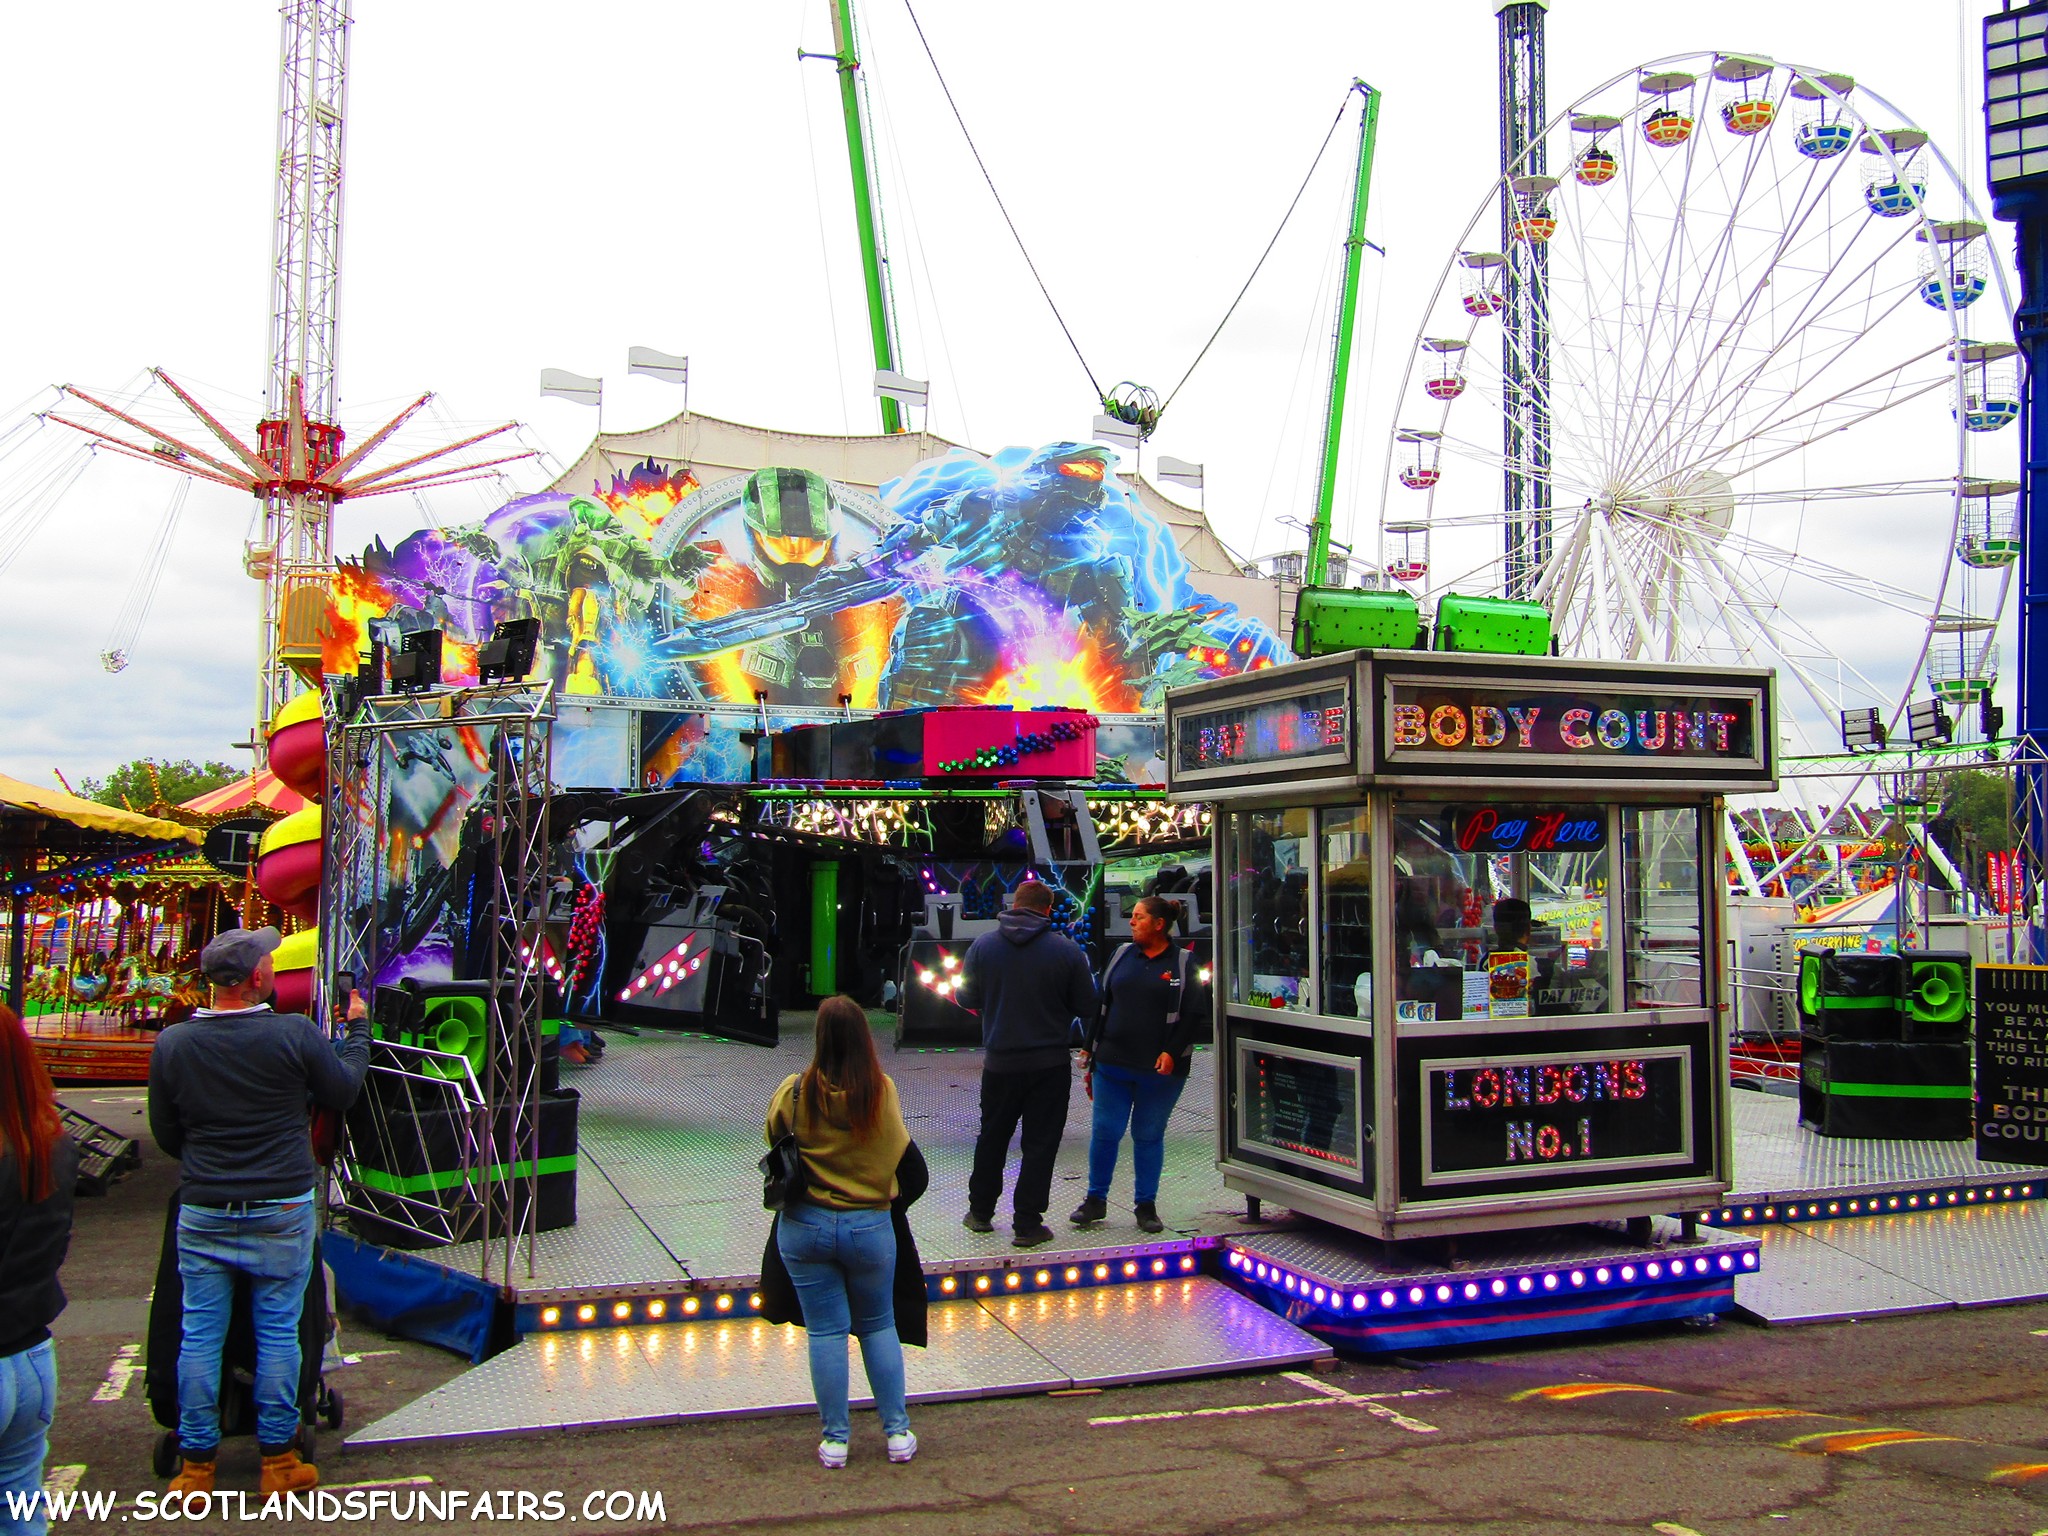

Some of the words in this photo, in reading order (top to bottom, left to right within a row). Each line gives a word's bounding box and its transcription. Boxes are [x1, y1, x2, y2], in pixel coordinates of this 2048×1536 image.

[1199, 722, 1247, 762] PAY
[1255, 704, 1345, 754] HERE
[1394, 704, 1540, 747] BODY
[1559, 708, 1737, 751] COUNT
[1461, 809, 1528, 850] Pay
[1531, 812, 1600, 850] Here
[1566, 917, 1589, 931] WIN
[1541, 990, 1565, 1003] PAY
[1570, 986, 1601, 1002] HERE
[1984, 1002, 2020, 1013] YOU
[2004, 1016, 2027, 1026] BE
[1993, 1029, 2038, 1041] TALL
[1986, 1041, 2027, 1053] THIS
[1995, 1055, 2018, 1065] TO
[1444, 1060, 1647, 1111] LONDONS
[1982, 1122, 2048, 1142] COU
